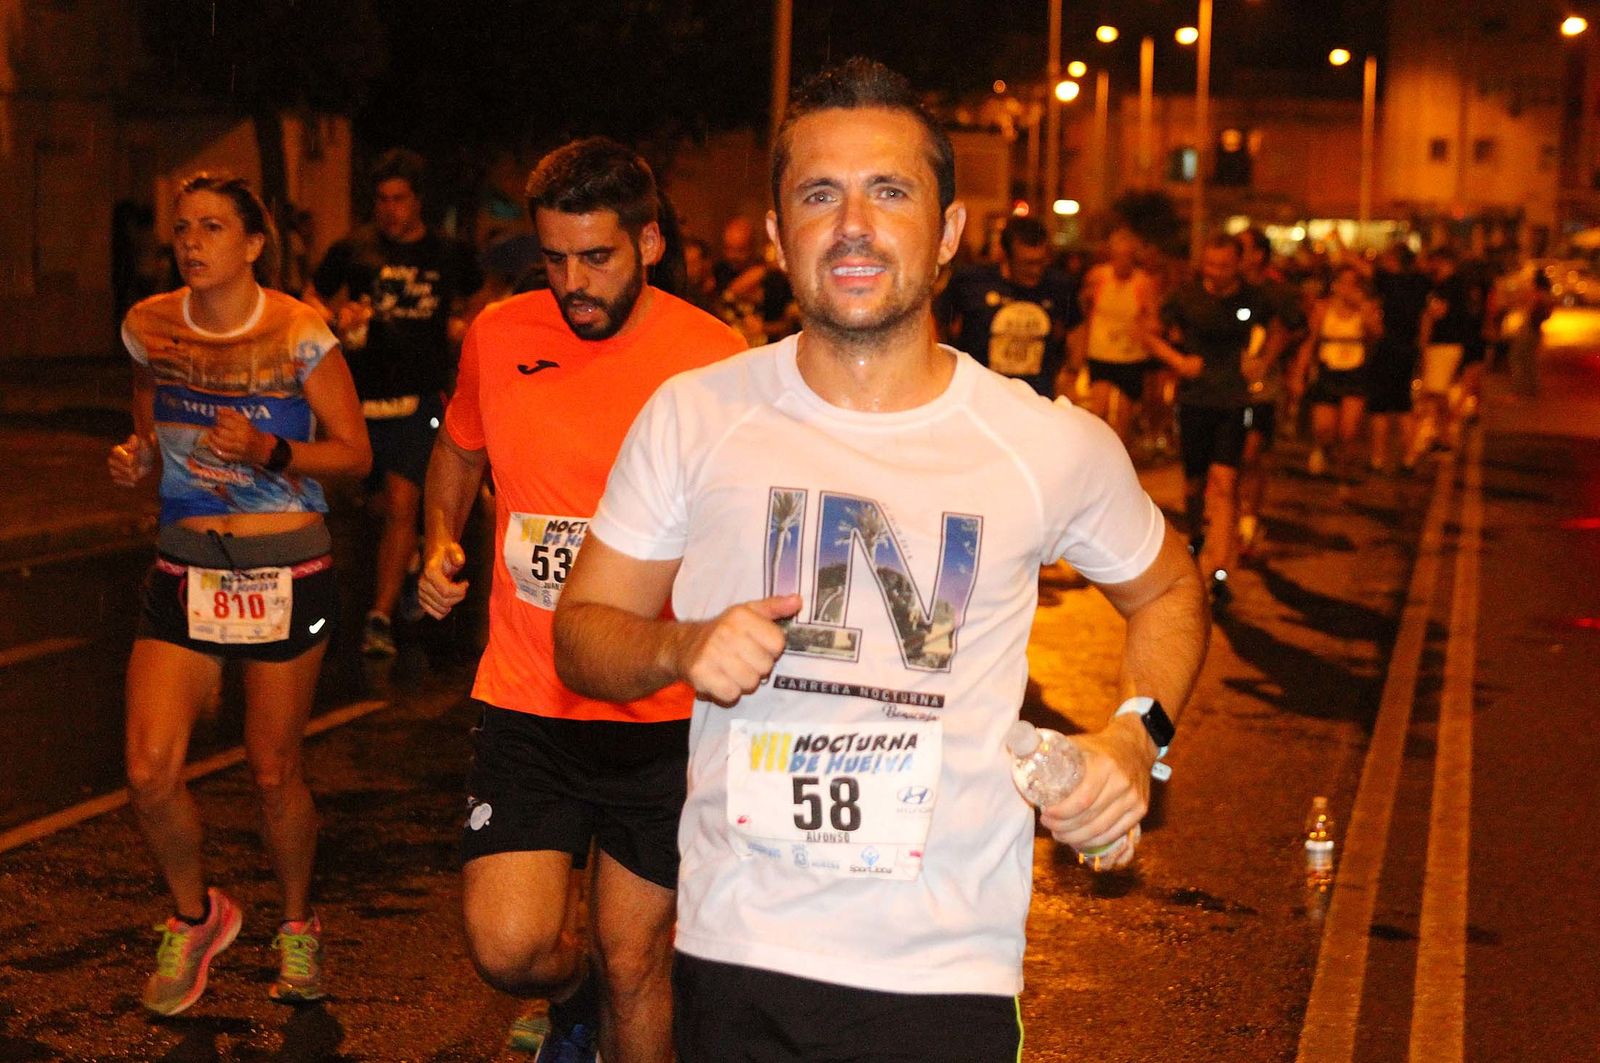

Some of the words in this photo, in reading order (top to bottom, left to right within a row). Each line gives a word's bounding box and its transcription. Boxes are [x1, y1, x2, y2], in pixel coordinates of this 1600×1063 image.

[531, 545, 573, 584] 53
[764, 486, 984, 673] IN
[213, 591, 266, 620] 810
[777, 676, 851, 695] CARRERA
[859, 685, 941, 707] NOCTURNA
[750, 732, 792, 772] VII
[794, 732, 918, 753] NOCTURNA
[788, 753, 819, 773] DE
[825, 752, 914, 775] HUELVA
[792, 776, 862, 831] 58
[806, 831, 850, 843] ALFONSO
